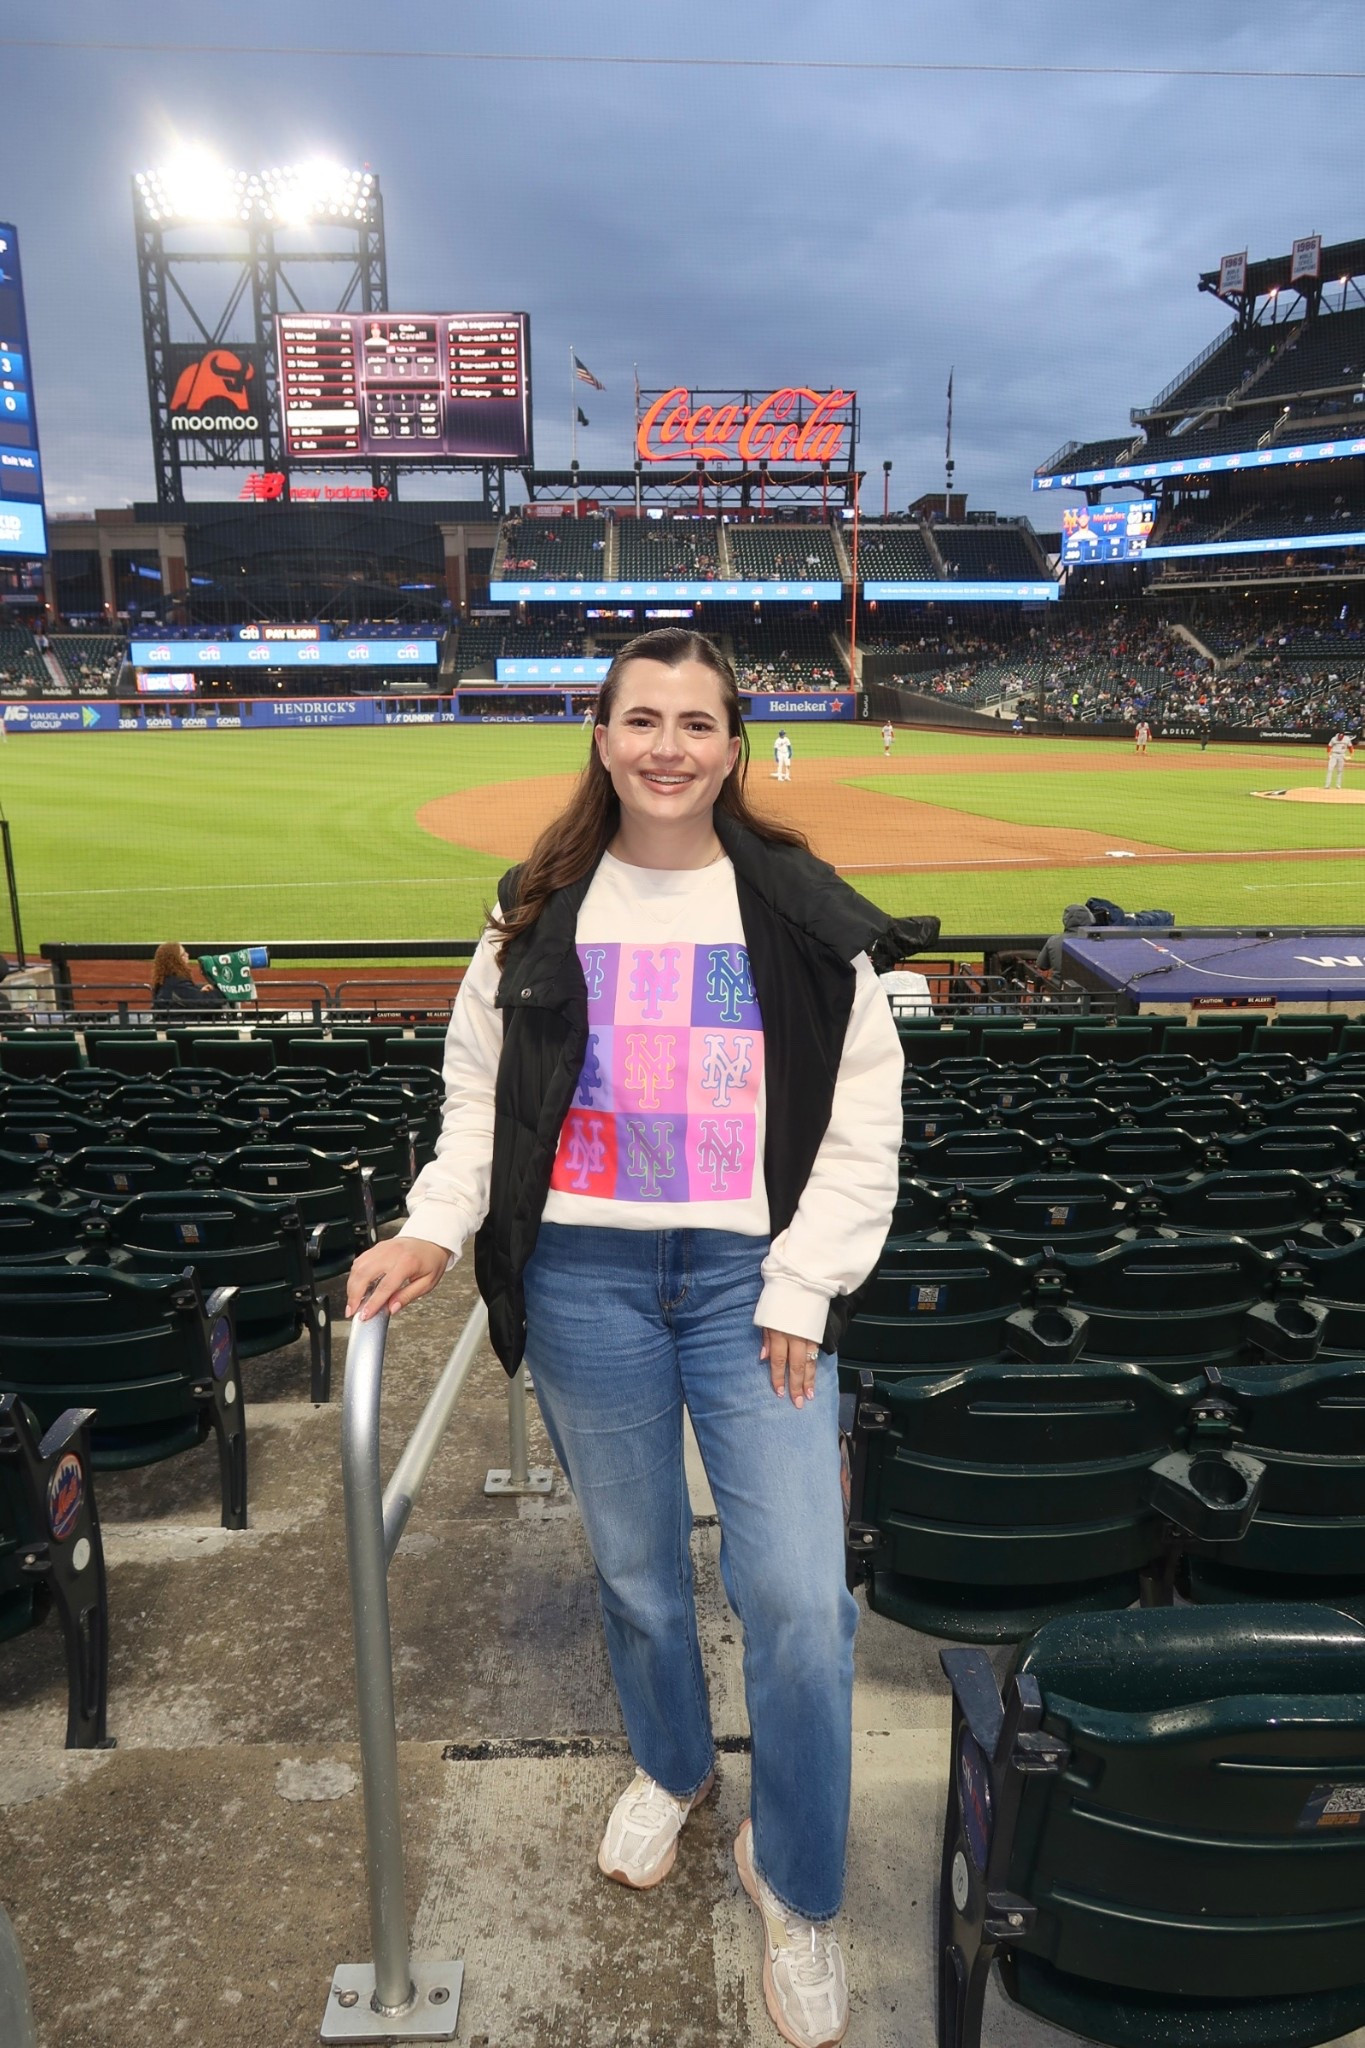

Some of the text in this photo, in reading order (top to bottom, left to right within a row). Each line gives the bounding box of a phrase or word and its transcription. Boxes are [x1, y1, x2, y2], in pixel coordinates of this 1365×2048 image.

[1297, 240, 1316, 253] 1986
[1225, 257, 1243, 268] 1969
[448, 321, 468, 332] pitch
[469, 322, 504, 332] sequence
[399, 332, 427, 340] Cavalli
[1, 358, 12, 373] 3
[299, 387, 321, 397] Young
[5, 396, 16, 411] 0
[171, 416, 259, 431] moomoo
[637, 387, 857, 462] Coca-Cola
[1038, 478, 1053, 489] 7:27
[290, 486, 321, 499] new
[324, 485, 389, 500] balance
[1093, 512, 1125, 522] Melendez
[239, 625, 317, 640] citi PAVILION
[149, 644, 419, 661] citi citi citi citi citi citi
[42, 687, 72, 696] HubSpot
[79, 686, 108, 696] HubSpot
[273, 702, 356, 714] HENDRICK'S
[769, 700, 826, 712] Heineken
[305, 715, 328, 723] GIN
[403, 714, 434, 723] DUNKIN'
[441, 713, 455, 722] 370
[31, 721, 61, 729] GROUP
[118, 719, 138, 729] 380
[1293, 955, 1365, 967] W
